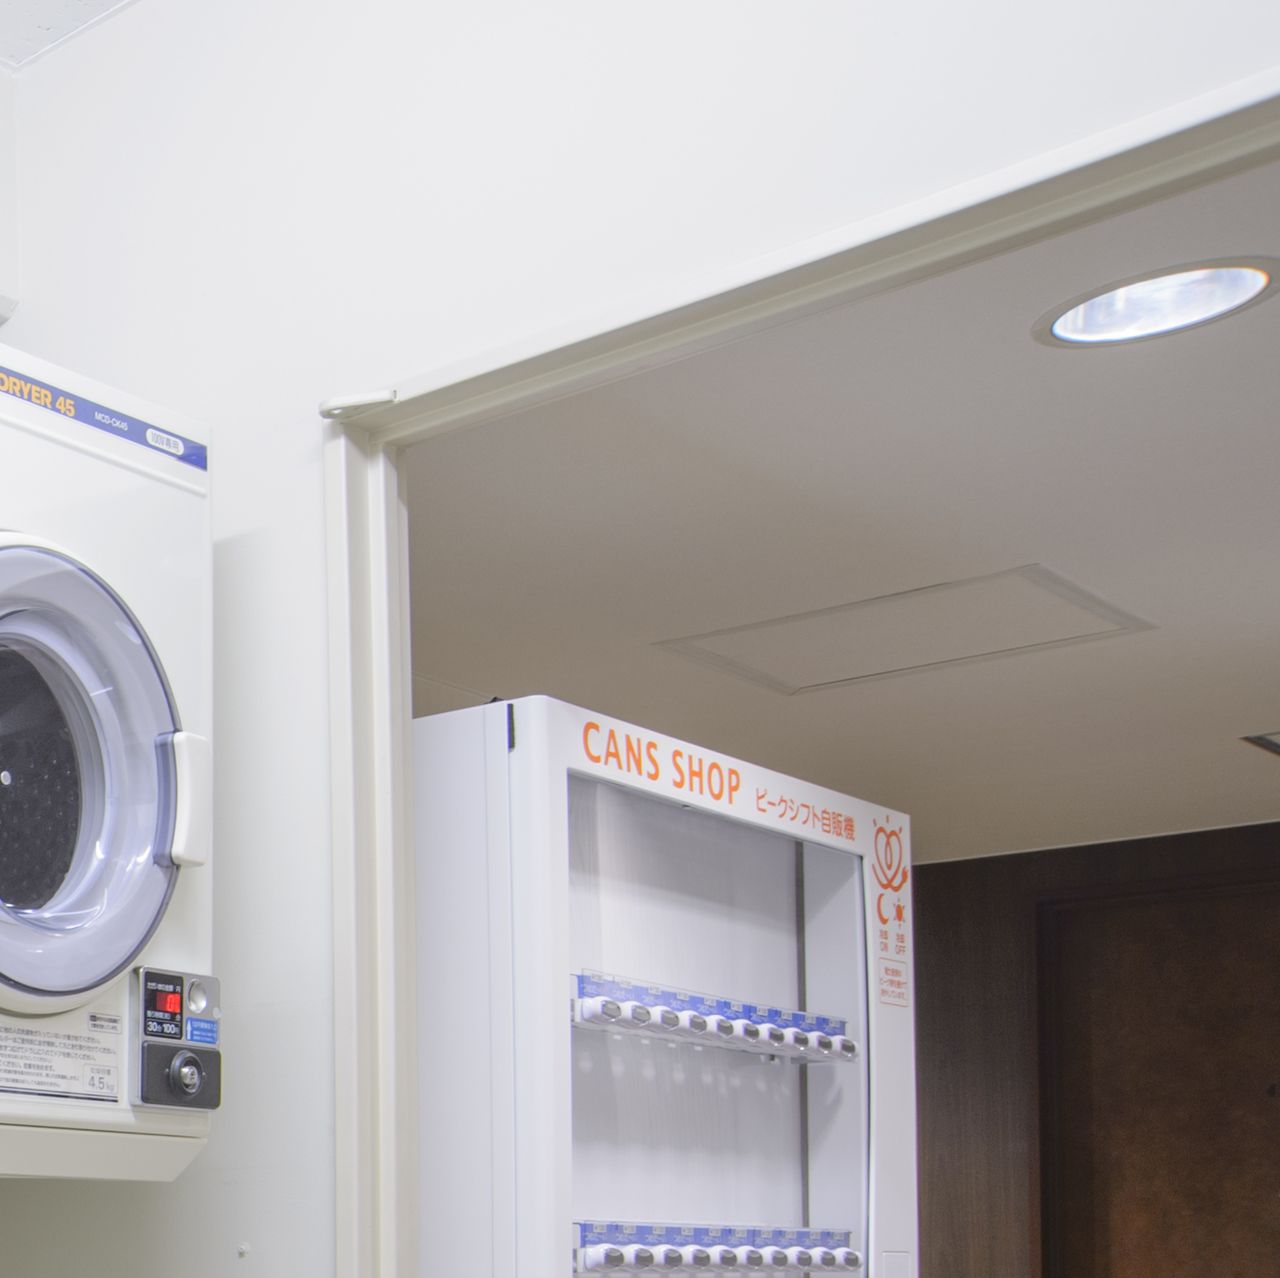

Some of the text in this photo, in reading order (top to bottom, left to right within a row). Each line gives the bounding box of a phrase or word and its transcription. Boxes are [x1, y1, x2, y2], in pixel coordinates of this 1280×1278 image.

[55, 396, 76, 417] 45
[582, 720, 741, 804] CANS SHOP
[755, 787, 856, 842] ピークシフト自販機
